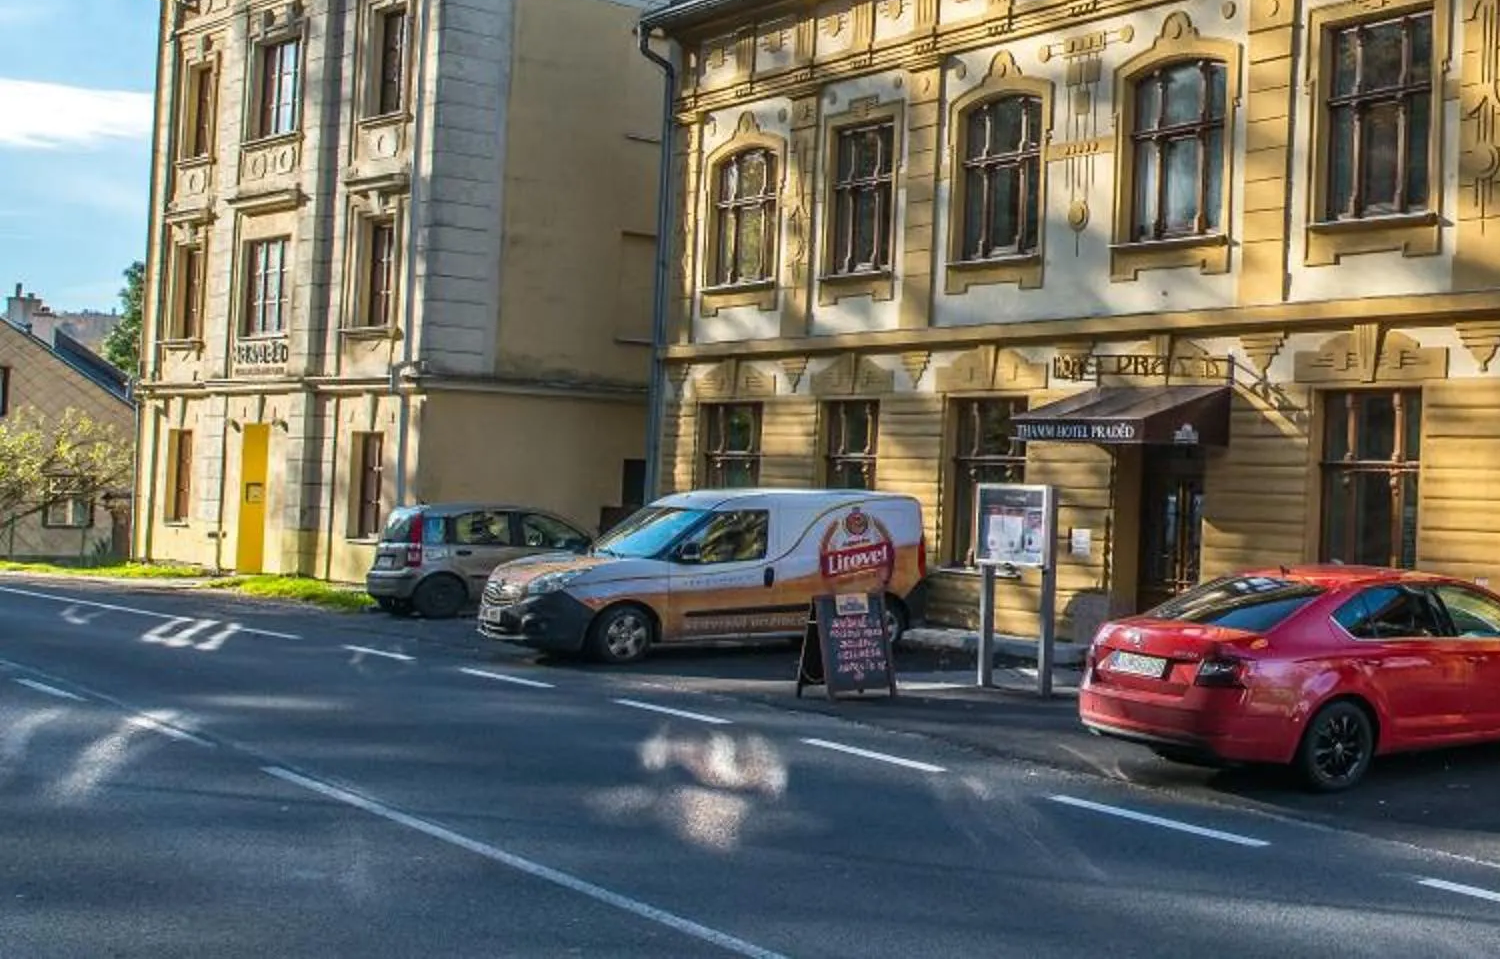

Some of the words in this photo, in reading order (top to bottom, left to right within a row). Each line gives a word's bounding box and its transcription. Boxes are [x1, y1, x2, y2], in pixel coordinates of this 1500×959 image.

[1056, 424, 1088, 438] HOTEL
[1091, 422, 1135, 438] PRADĚD
[828, 544, 888, 574] Litovel
